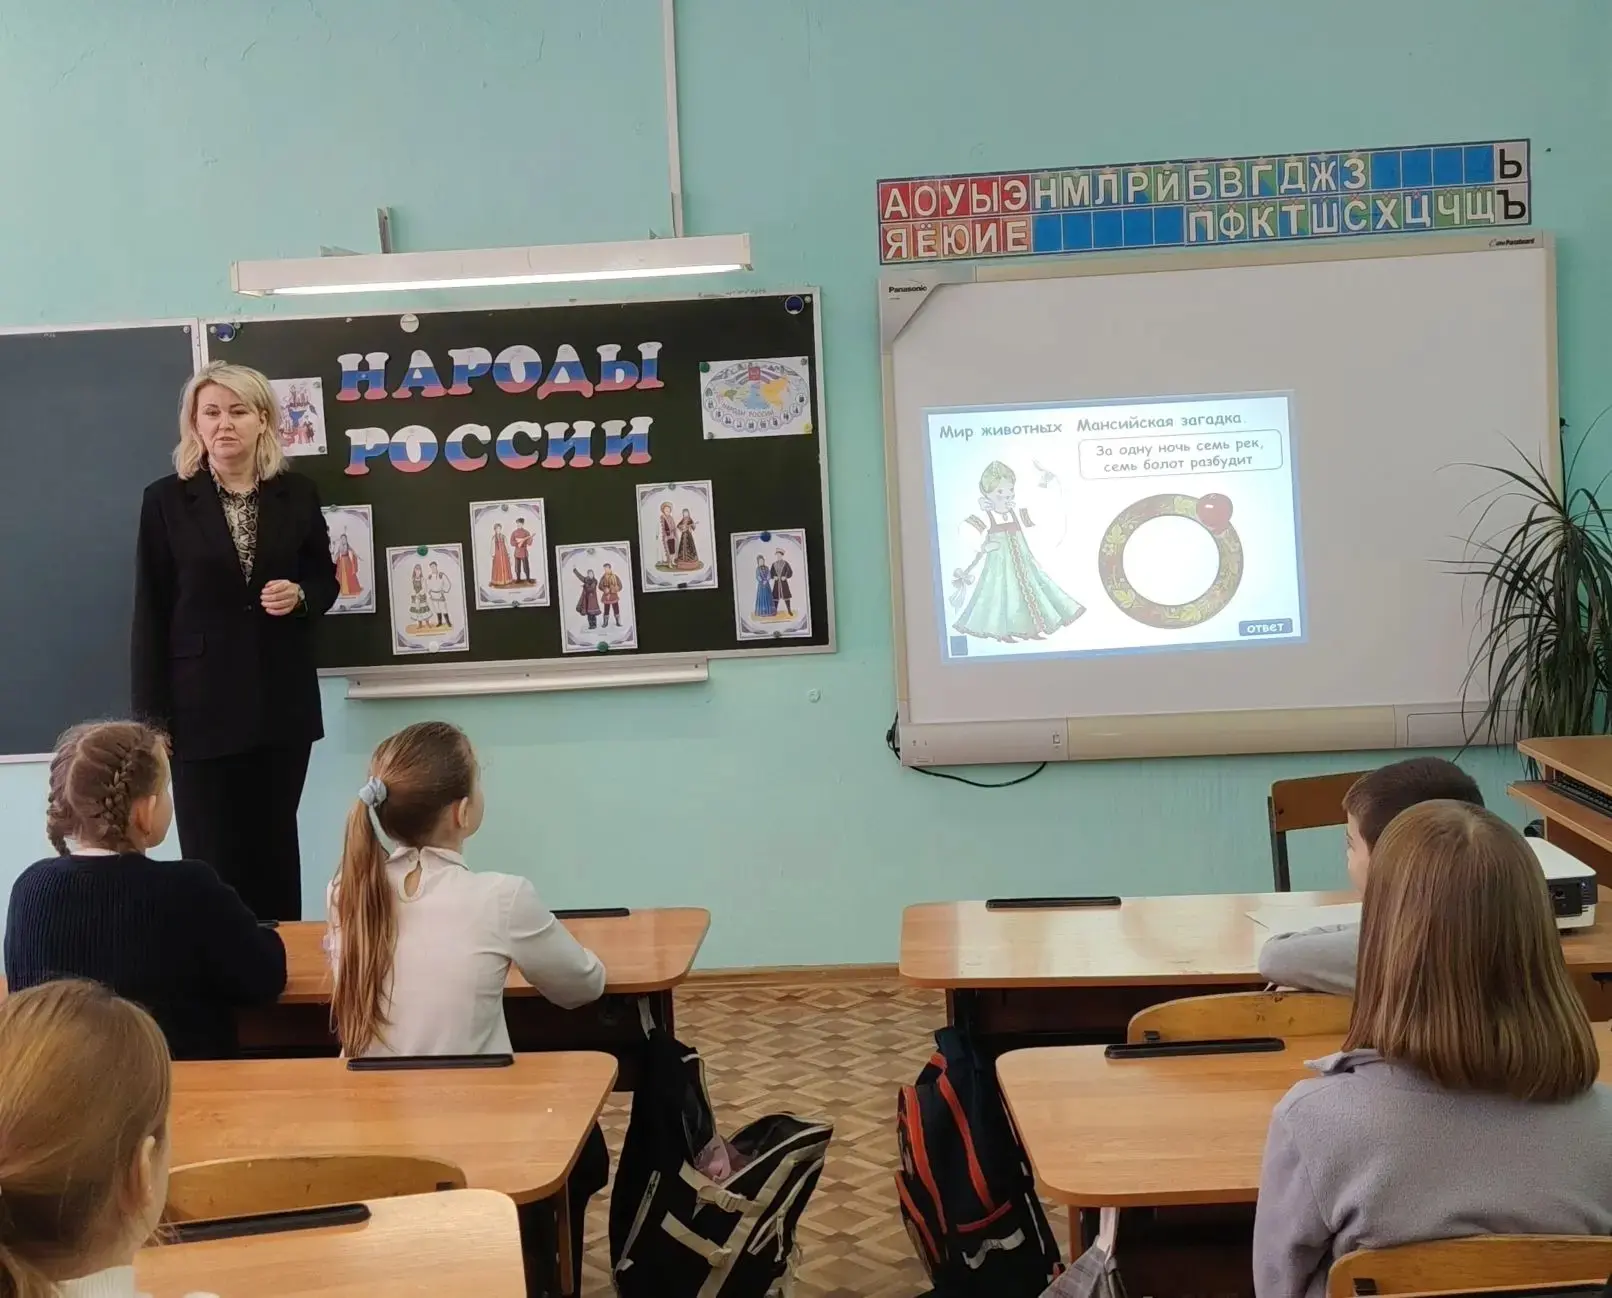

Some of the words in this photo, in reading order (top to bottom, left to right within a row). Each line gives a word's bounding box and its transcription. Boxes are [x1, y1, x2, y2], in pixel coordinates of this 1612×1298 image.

[888, 285, 928, 293] Panasonic
[335, 341, 665, 401] НАРОДЫ
[939, 425, 974, 441] Мир
[981, 423, 1063, 437] животных
[1077, 415, 1174, 432] Мансийская
[344, 416, 654, 476] РОССИИ
[1096, 445, 1113, 457] За
[1119, 444, 1152, 457] одну
[1158, 442, 1191, 453] ночь
[1196, 439, 1230, 450] семь
[1235, 439, 1265, 452] рек,
[1103, 461, 1138, 472] семь
[1143, 458, 1184, 470] болот
[1190, 454, 1253, 470] разбудит
